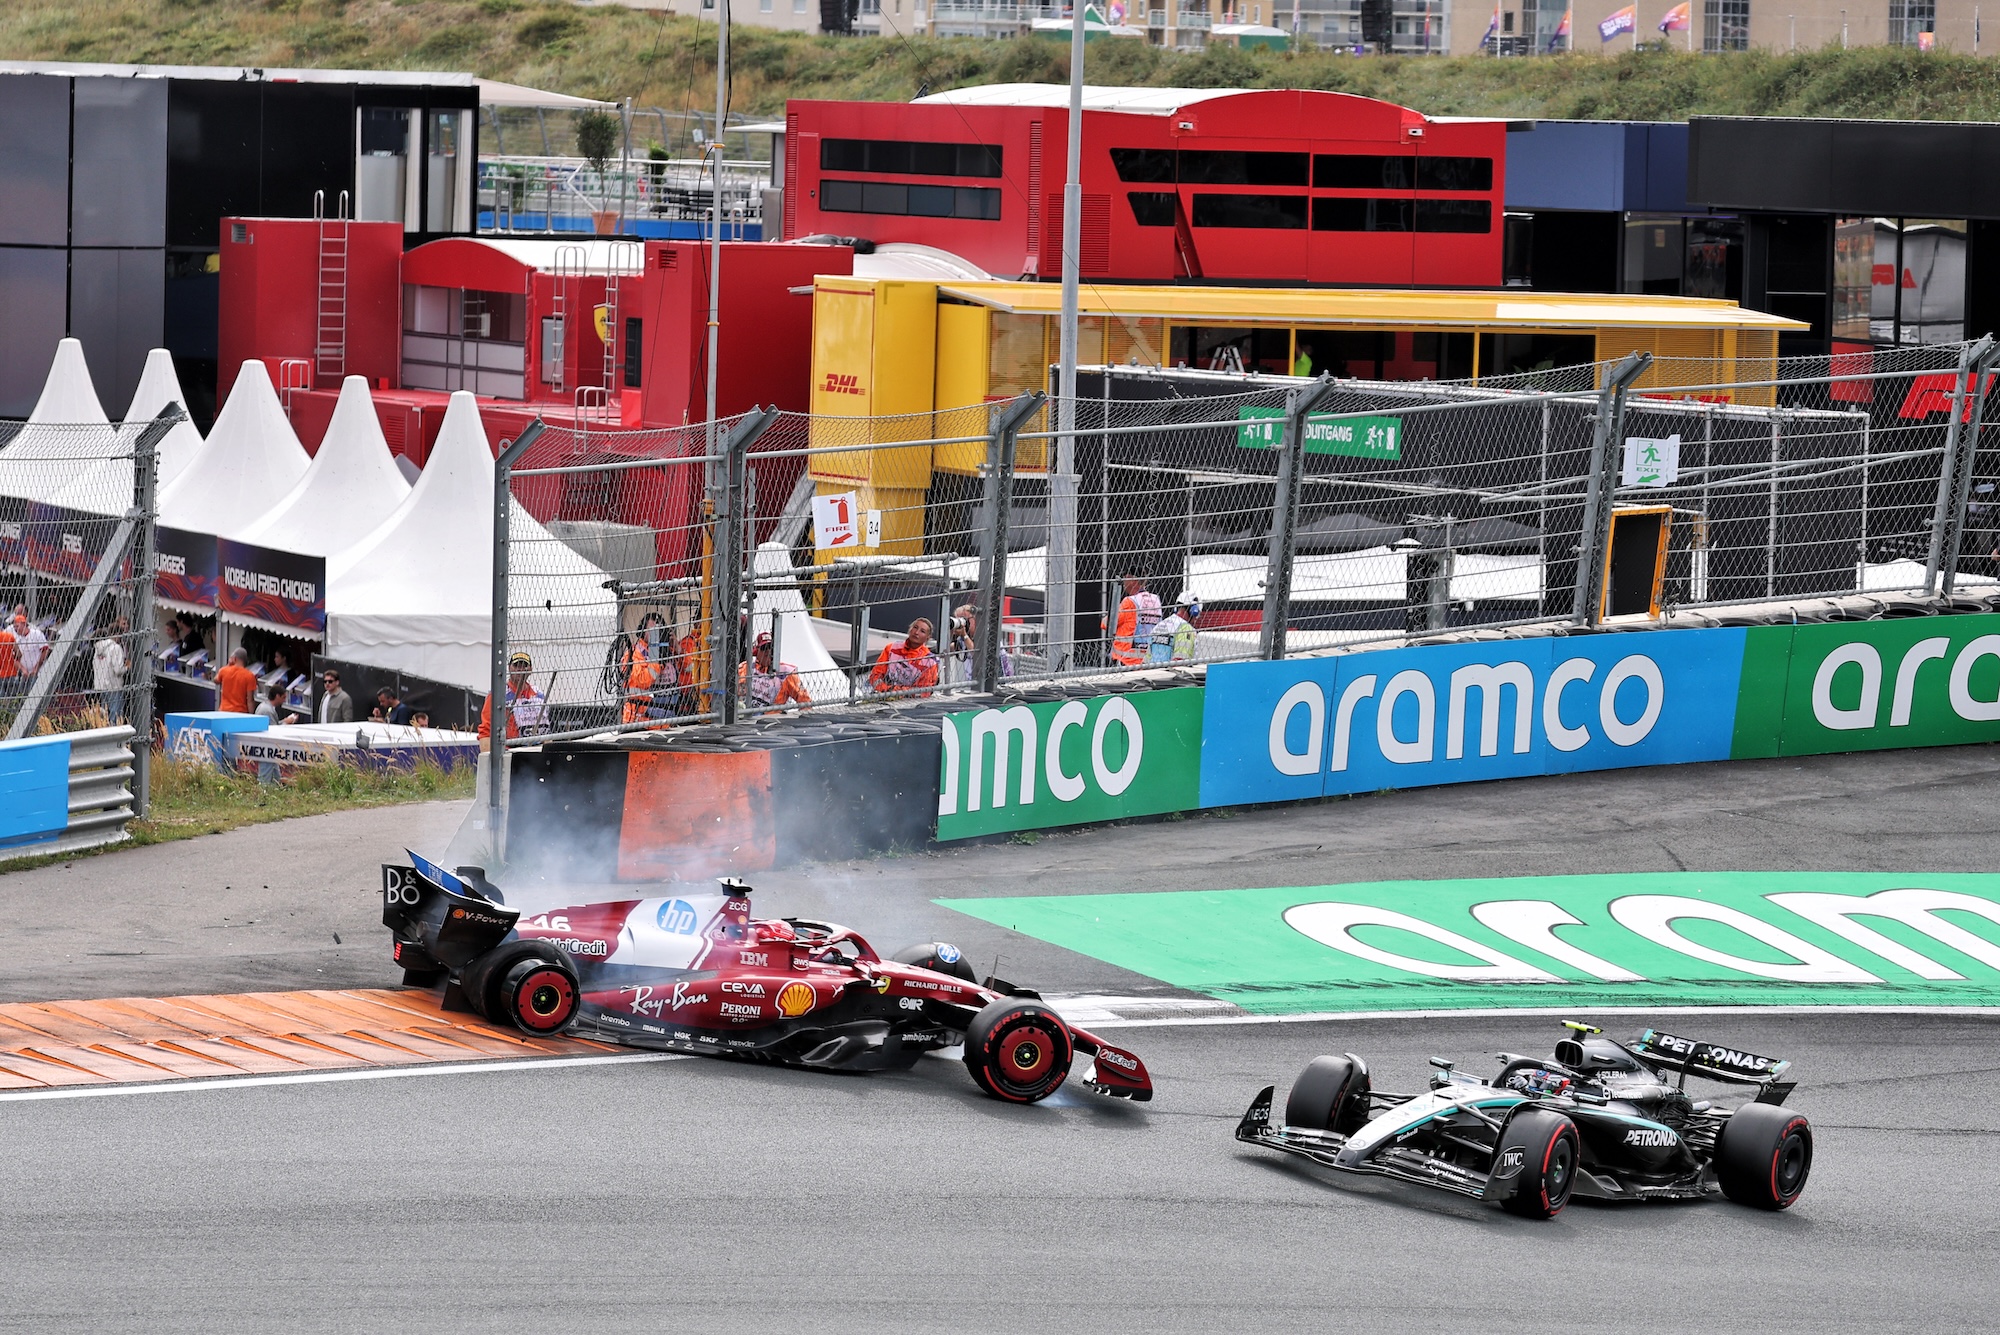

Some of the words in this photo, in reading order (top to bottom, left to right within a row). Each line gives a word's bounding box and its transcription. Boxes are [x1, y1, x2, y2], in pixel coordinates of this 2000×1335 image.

[819, 373, 865, 395] DHL
[1305, 423, 1353, 443] DUITGANG
[825, 525, 850, 533] FIRE
[868, 521, 879, 535] 3.4
[62, 533, 82, 553] FRIES
[224, 565, 257, 592] KOREAN
[258, 573, 280, 596] FRIED
[281, 578, 315, 603] CHICKEN
[1268, 654, 1664, 776] aramco
[465, 911, 509, 925] V-Power
[661, 899, 694, 935] hp
[740, 951, 768, 967] IBM
[793, 958, 809, 967] aws
[721, 982, 765, 994] CEVA
[904, 980, 938, 991] RICHARD
[939, 984, 962, 993] MILLE
[720, 1002, 761, 1016] PERONI
[600, 1013, 631, 1027] brembo
[988, 1011, 1023, 1042] ZERO
[642, 1024, 665, 1035] MAHLE
[674, 1031, 692, 1040] NGK
[699, 1035, 719, 1044] SKF
[901, 1032, 933, 1042] ambipar
[1107, 1051, 1138, 1070] UniCredit
[1247, 1107, 1270, 1121] INEOS
[1623, 1129, 1677, 1147] PETRONAS
[1430, 1158, 1466, 1174] PETRONAS
[1503, 1152, 1523, 1167] IWC
